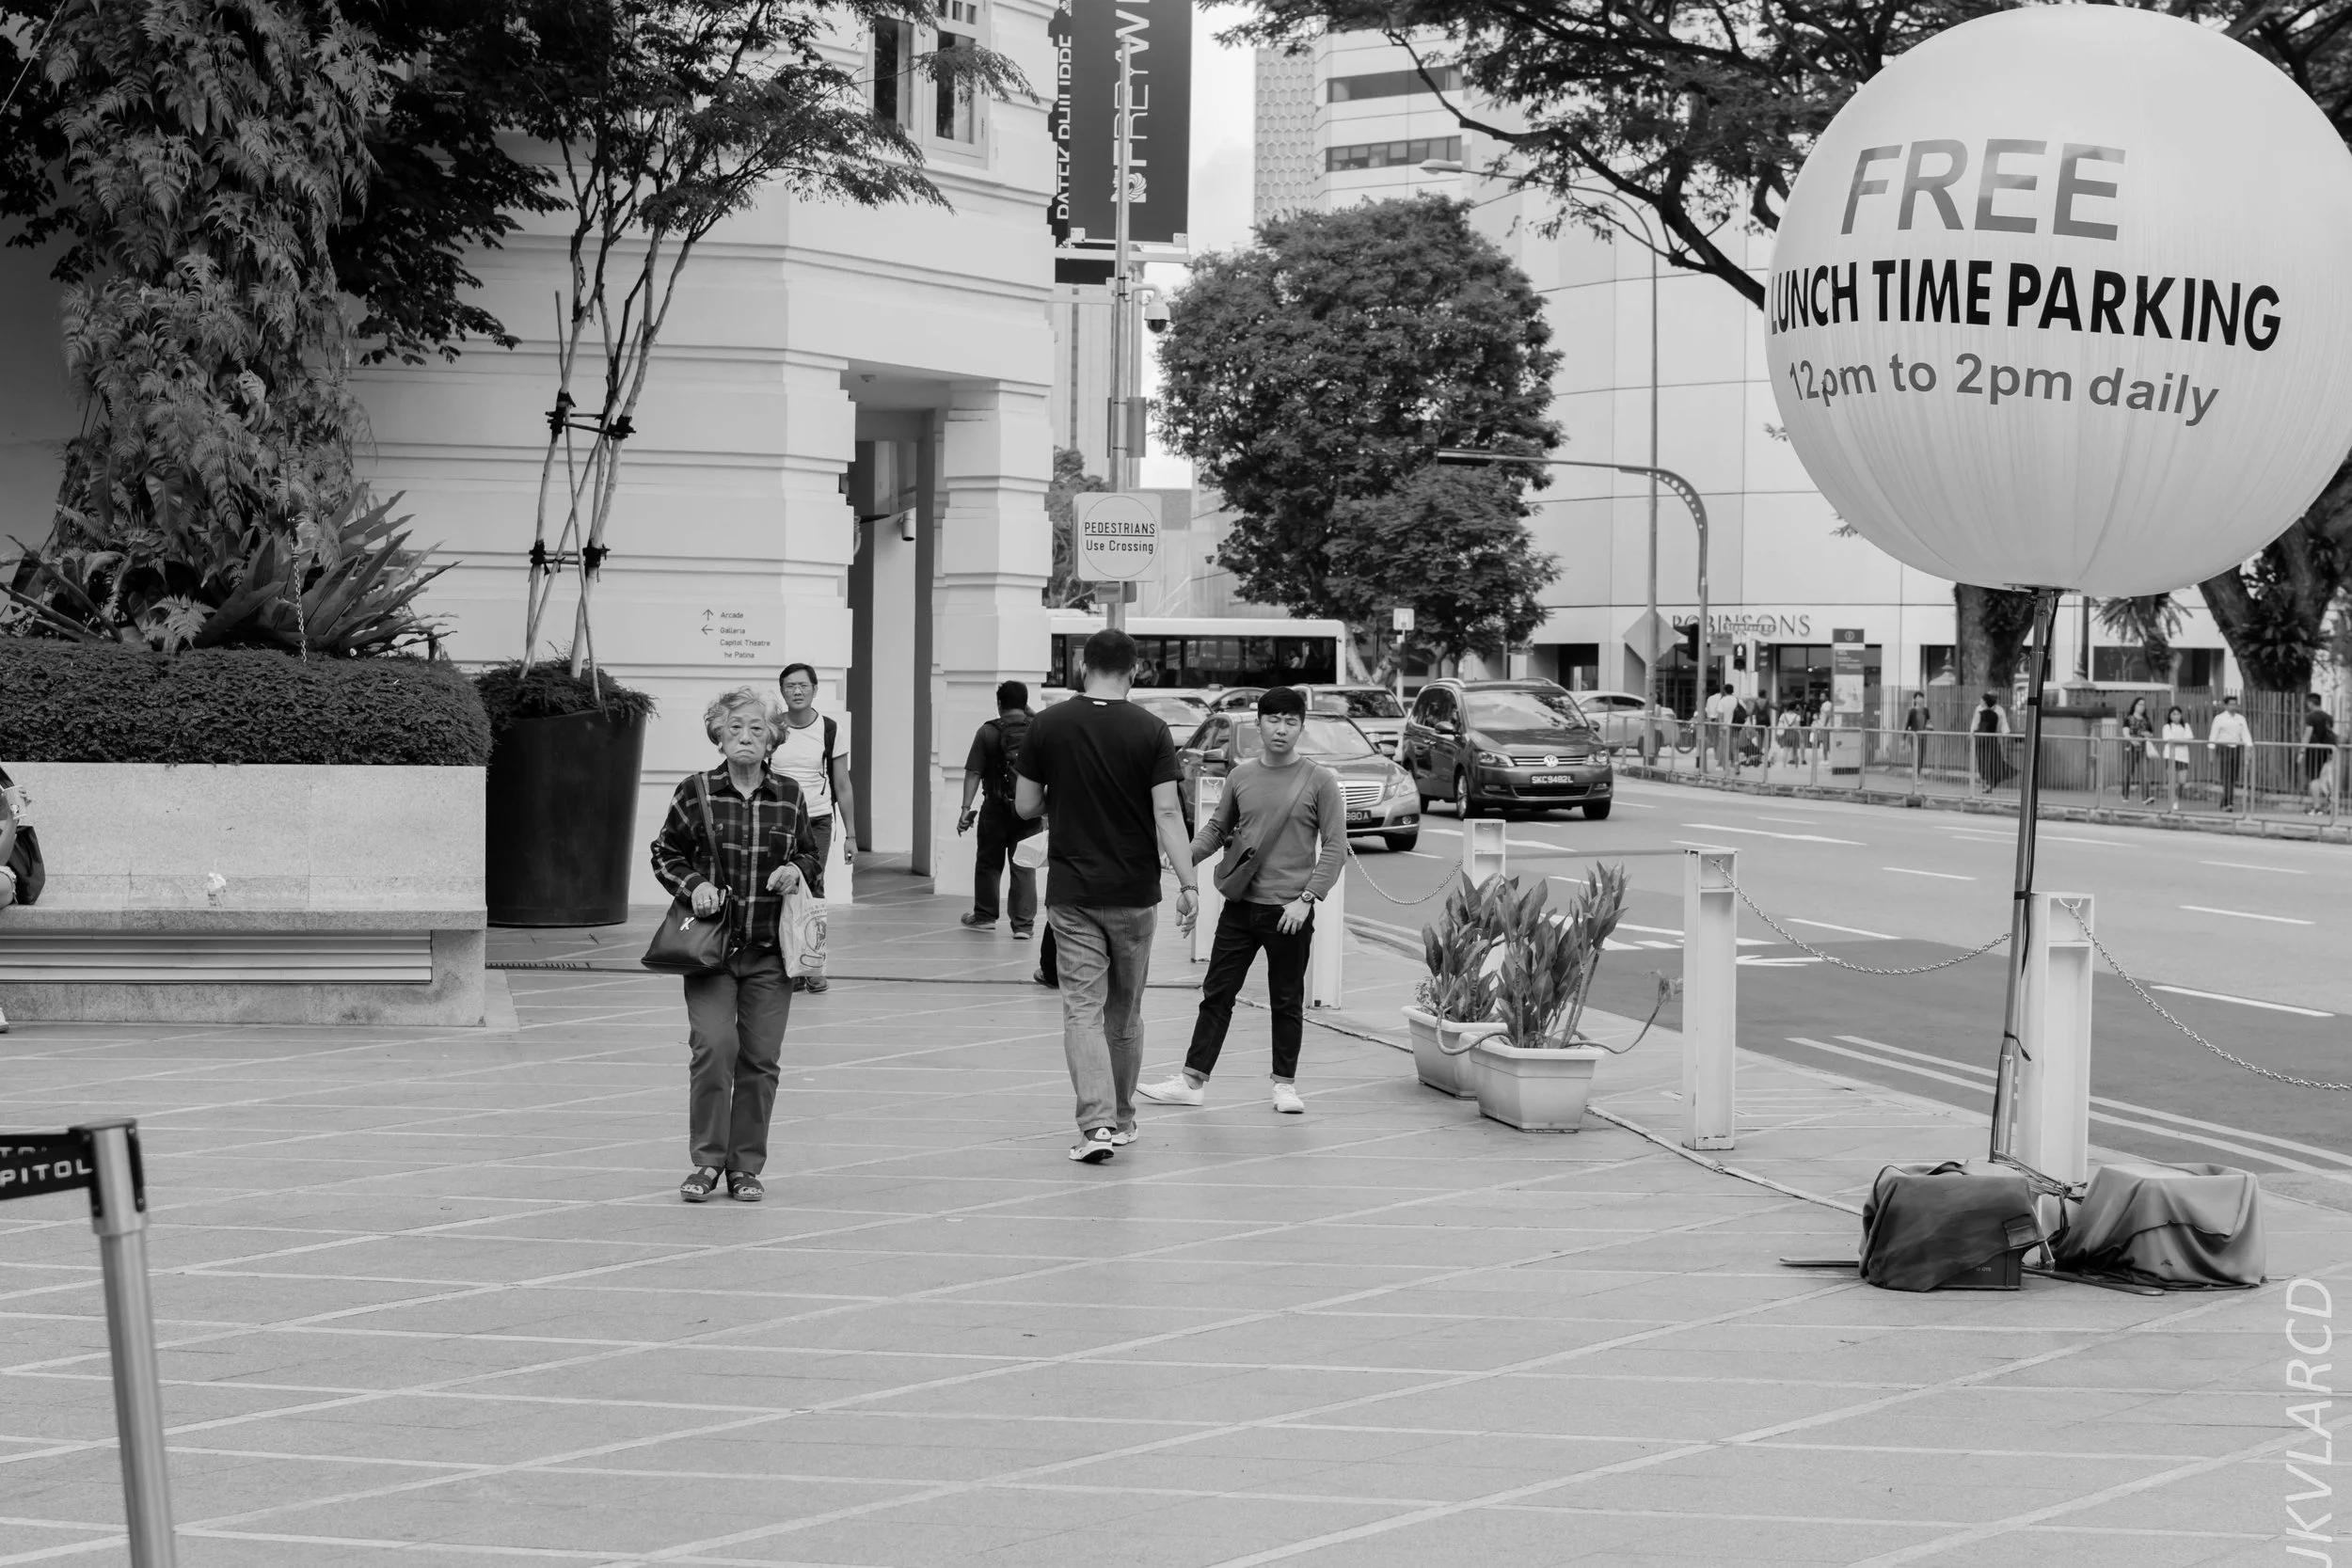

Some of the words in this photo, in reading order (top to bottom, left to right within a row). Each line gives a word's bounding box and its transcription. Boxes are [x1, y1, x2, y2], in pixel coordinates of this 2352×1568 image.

[1840, 138, 2126, 241] FREE
[1772, 261, 1858, 335] LUNCH
[1871, 259, 1993, 325] TIME
[2007, 262, 2282, 352] PARKING
[1789, 356, 1878, 408] 12pm
[1888, 352, 1937, 393] to
[1956, 353, 2073, 405] 2pm
[2089, 367, 2220, 427] daily
[1085, 522, 1155, 534] PEDESTRIANS
[1086, 540, 1104, 551] Use
[1109, 540, 1153, 554] Crossing
[720, 639, 743, 647] Capitol
